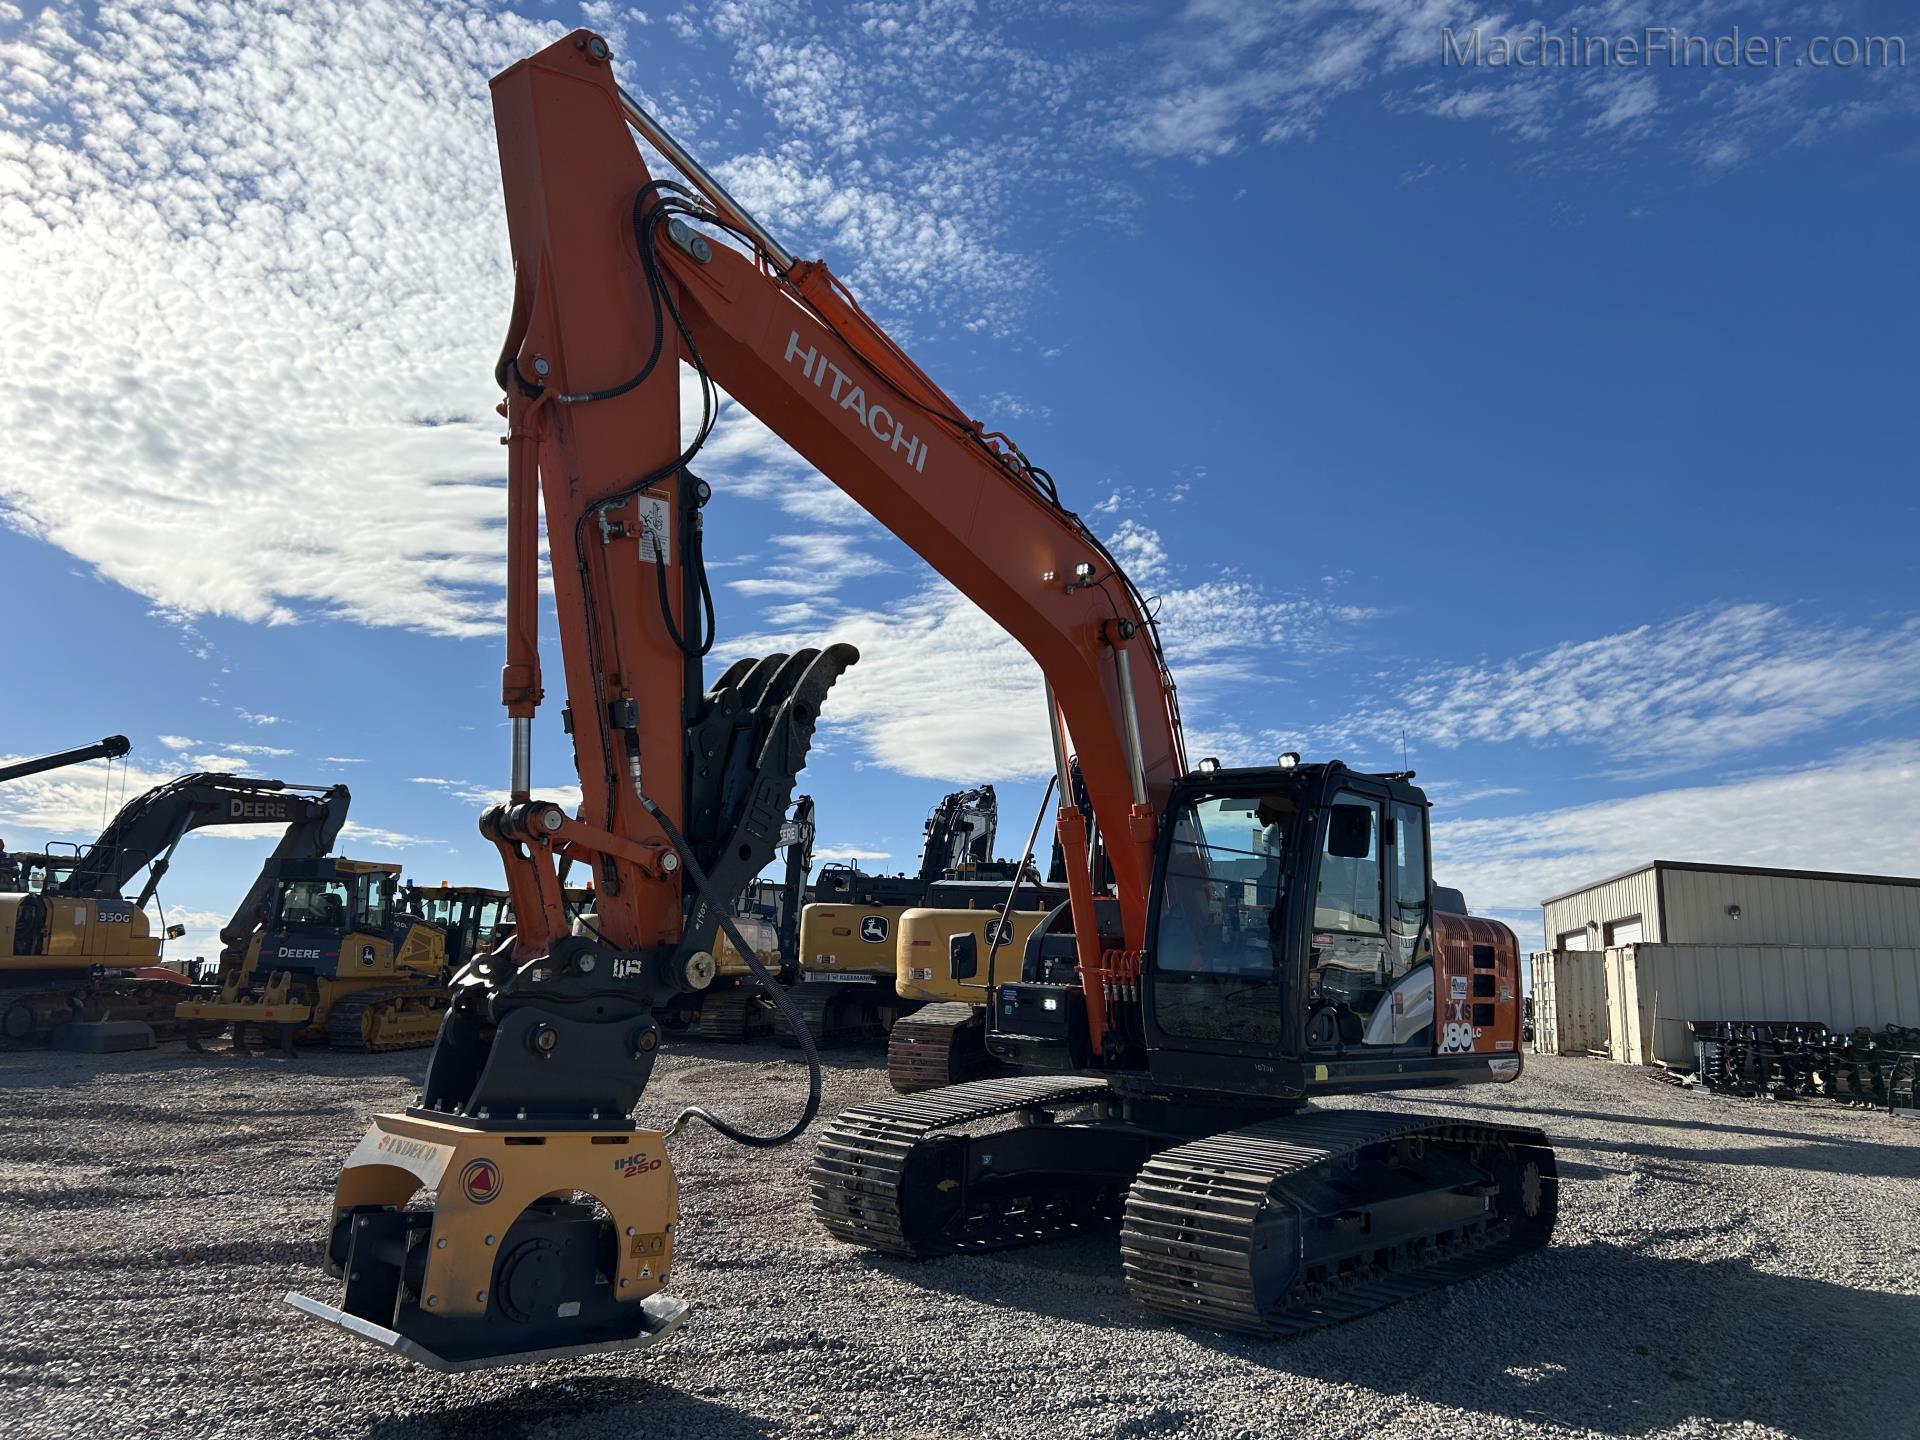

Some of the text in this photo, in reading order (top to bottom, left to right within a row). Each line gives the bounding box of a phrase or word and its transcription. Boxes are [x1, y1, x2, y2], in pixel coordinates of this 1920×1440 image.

[784, 329, 929, 474] HITACHI
[230, 798, 287, 818] DEERE
[99, 912, 130, 923] 350G
[278, 946, 321, 959] DEERE
[1444, 1004, 1472, 1021] ZAXIS
[1472, 1028, 1483, 1039] LC
[614, 1152, 647, 1170] IHC
[623, 1159, 662, 1179] 250
